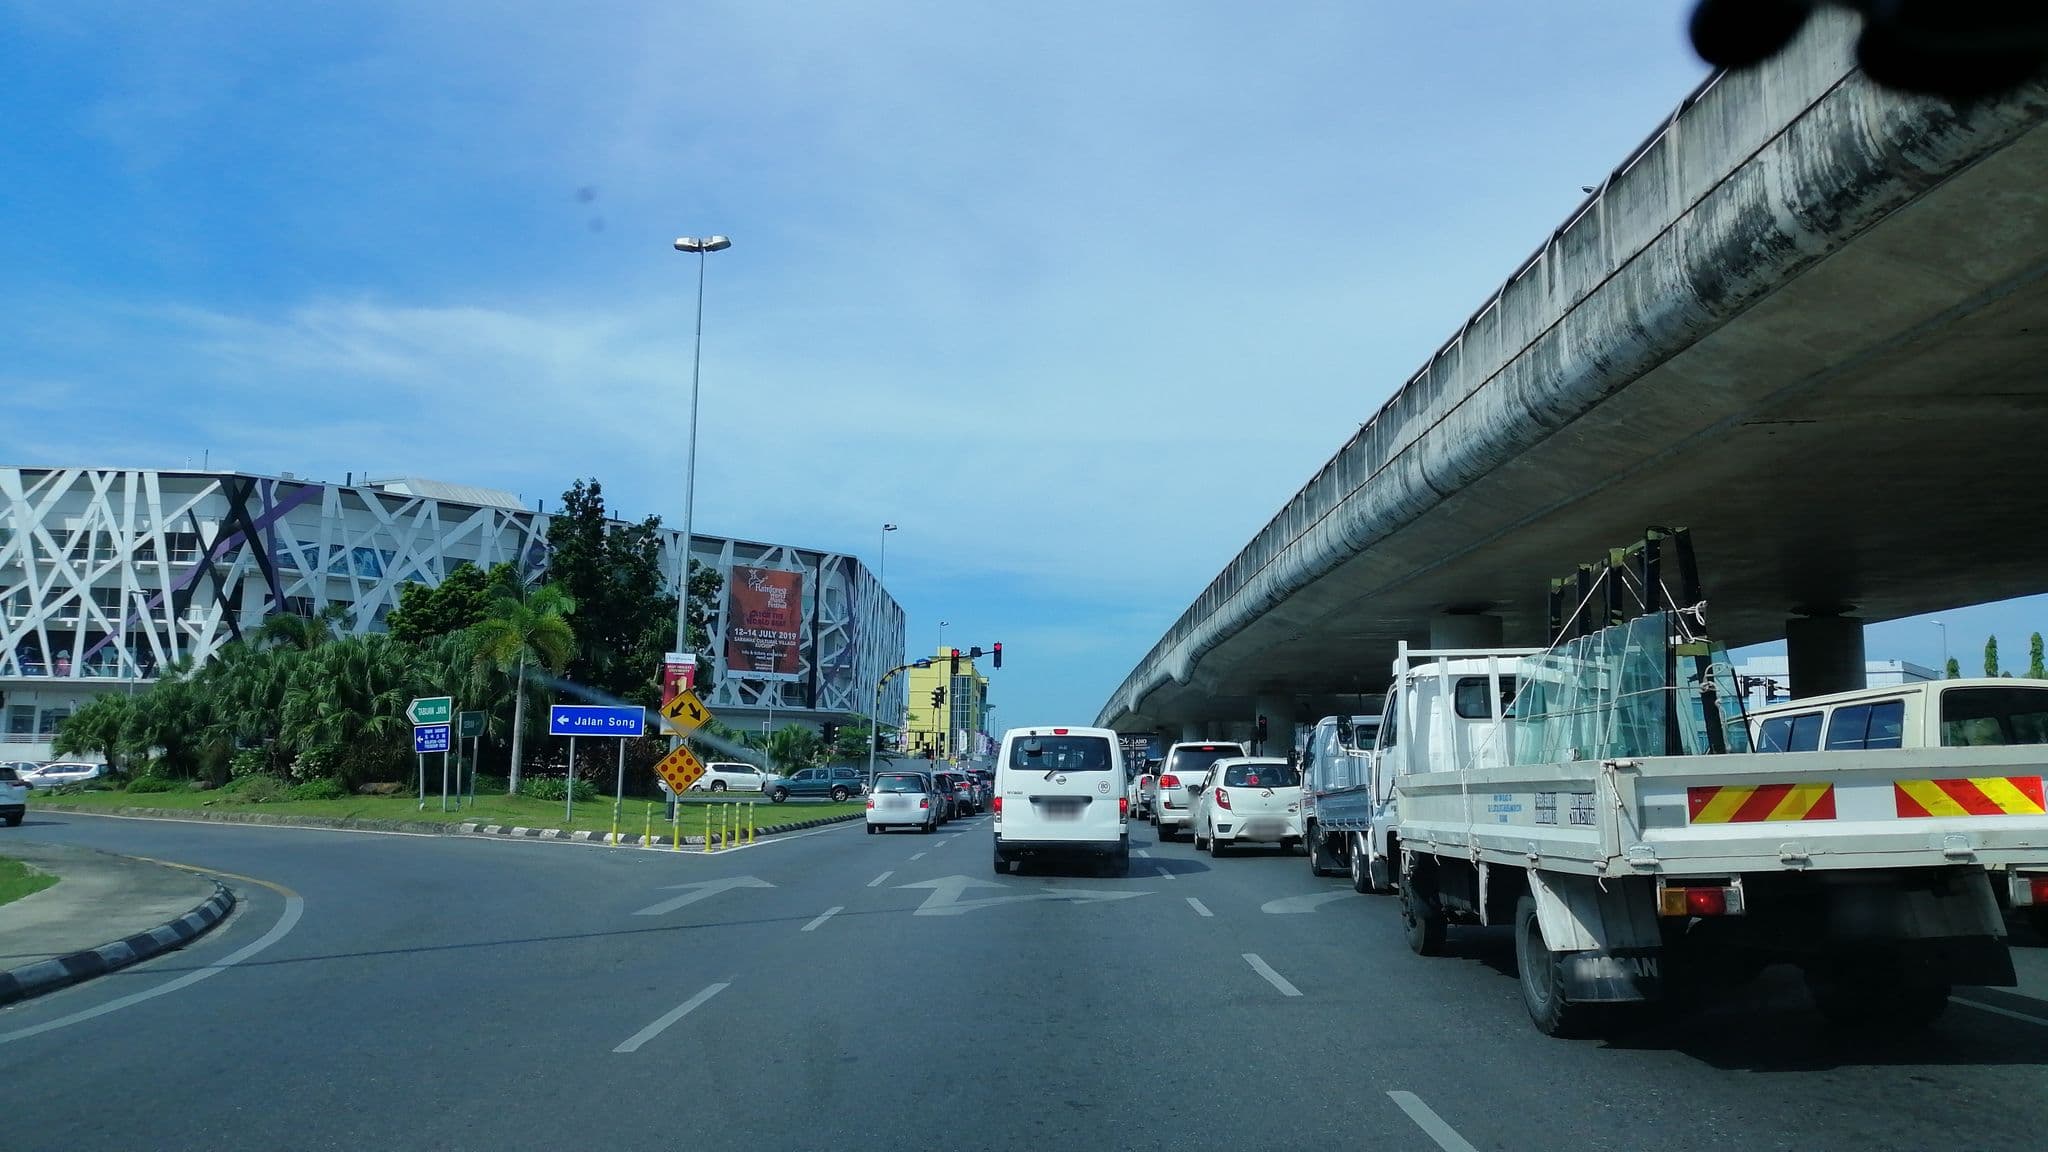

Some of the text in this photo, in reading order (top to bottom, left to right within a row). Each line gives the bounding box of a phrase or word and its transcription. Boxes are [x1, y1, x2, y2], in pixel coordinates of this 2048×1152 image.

[758, 630, 777, 638] JULY
[778, 632, 797, 640] 2019
[574, 716, 636, 729] Jalan Song
